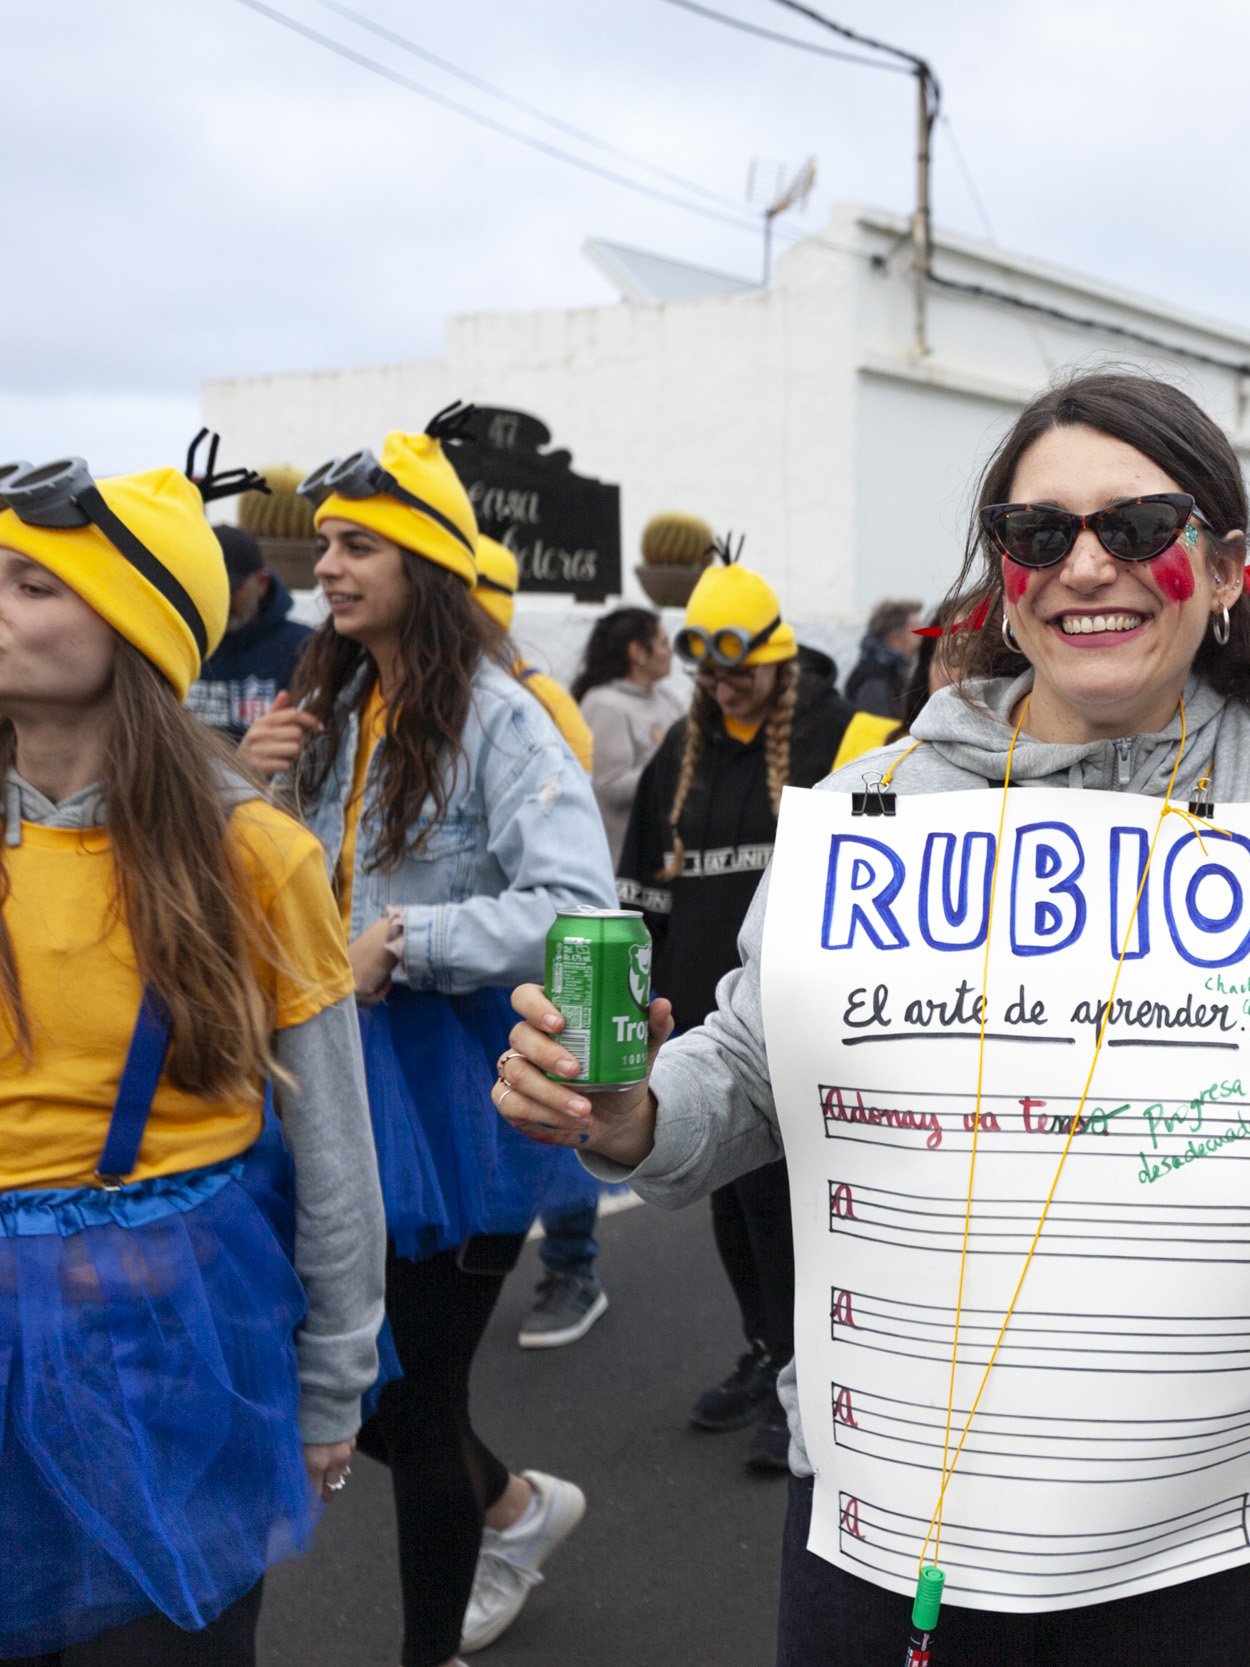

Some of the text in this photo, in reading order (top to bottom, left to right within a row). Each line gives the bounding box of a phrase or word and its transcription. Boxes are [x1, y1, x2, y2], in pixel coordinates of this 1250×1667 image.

[842, 979, 1246, 1050] El arte de aprender.
[822, 1087, 943, 1150] Adonay
[963, 1111, 1001, 1132] va
